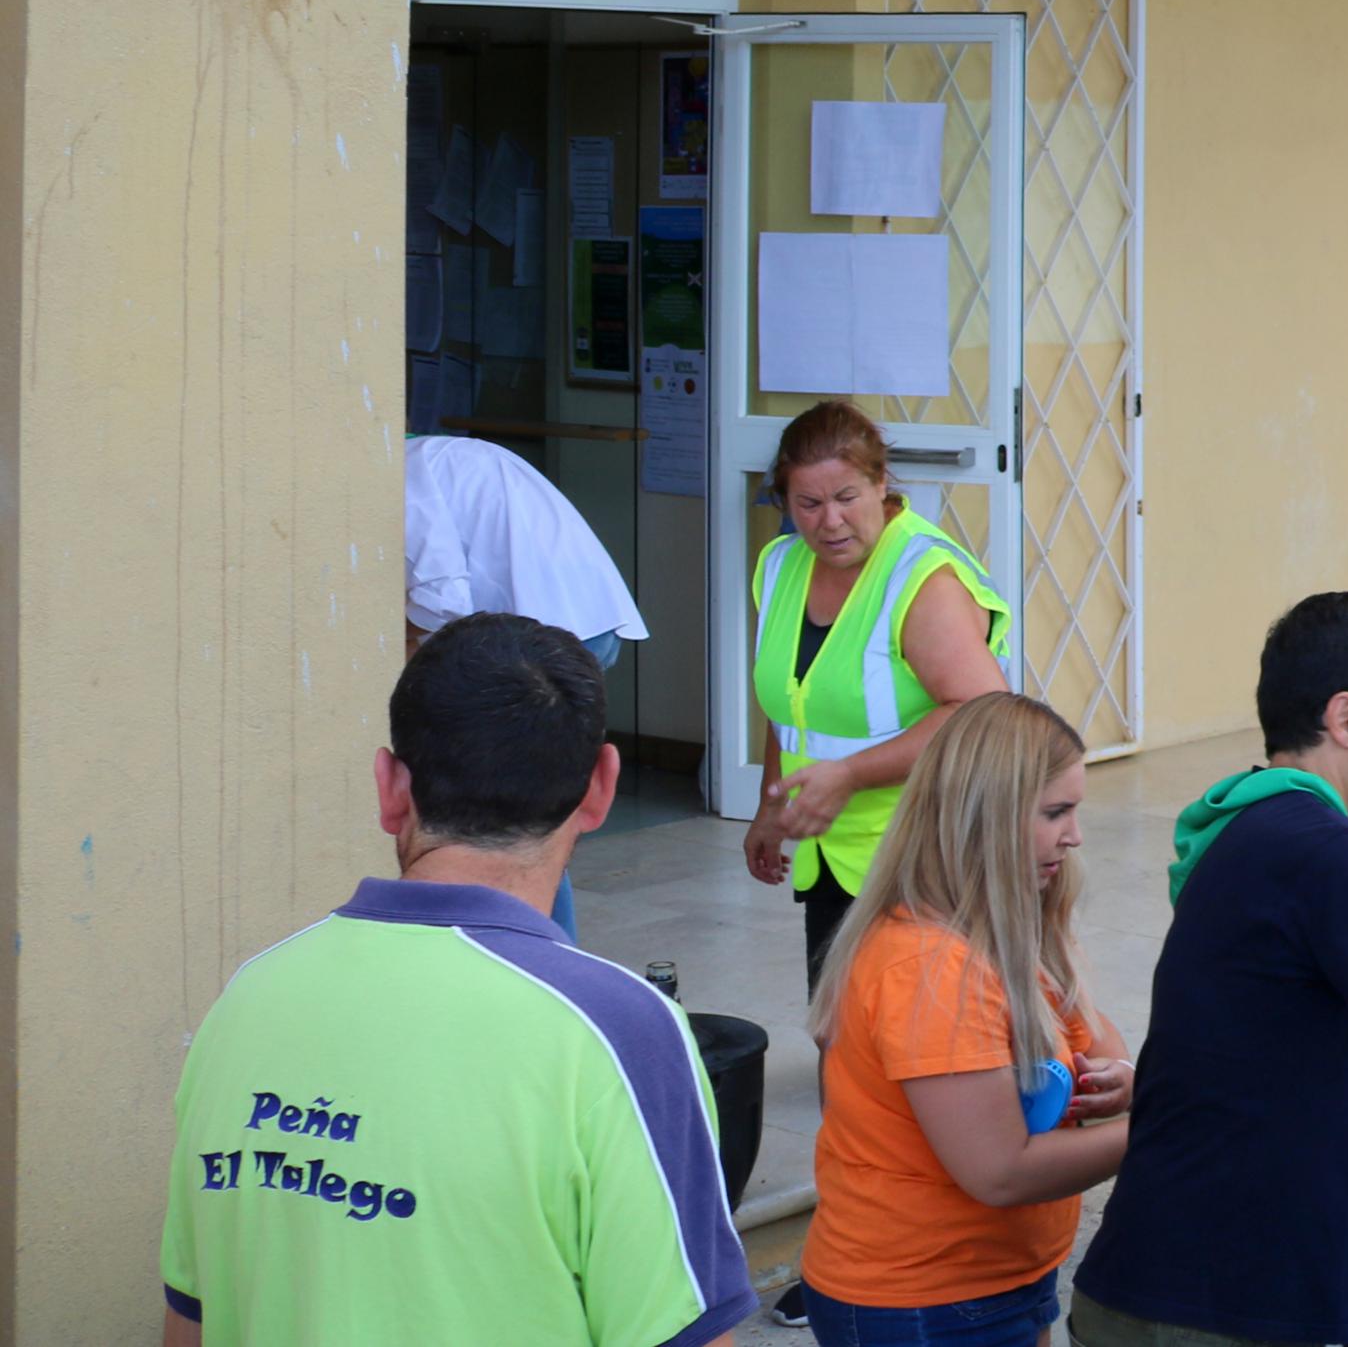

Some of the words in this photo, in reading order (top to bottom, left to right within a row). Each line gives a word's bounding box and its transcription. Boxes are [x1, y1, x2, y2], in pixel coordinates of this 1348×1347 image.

[245, 1092, 362, 1142] Peña
[198, 1150, 242, 1191] El
[253, 1150, 417, 1221] Talego
